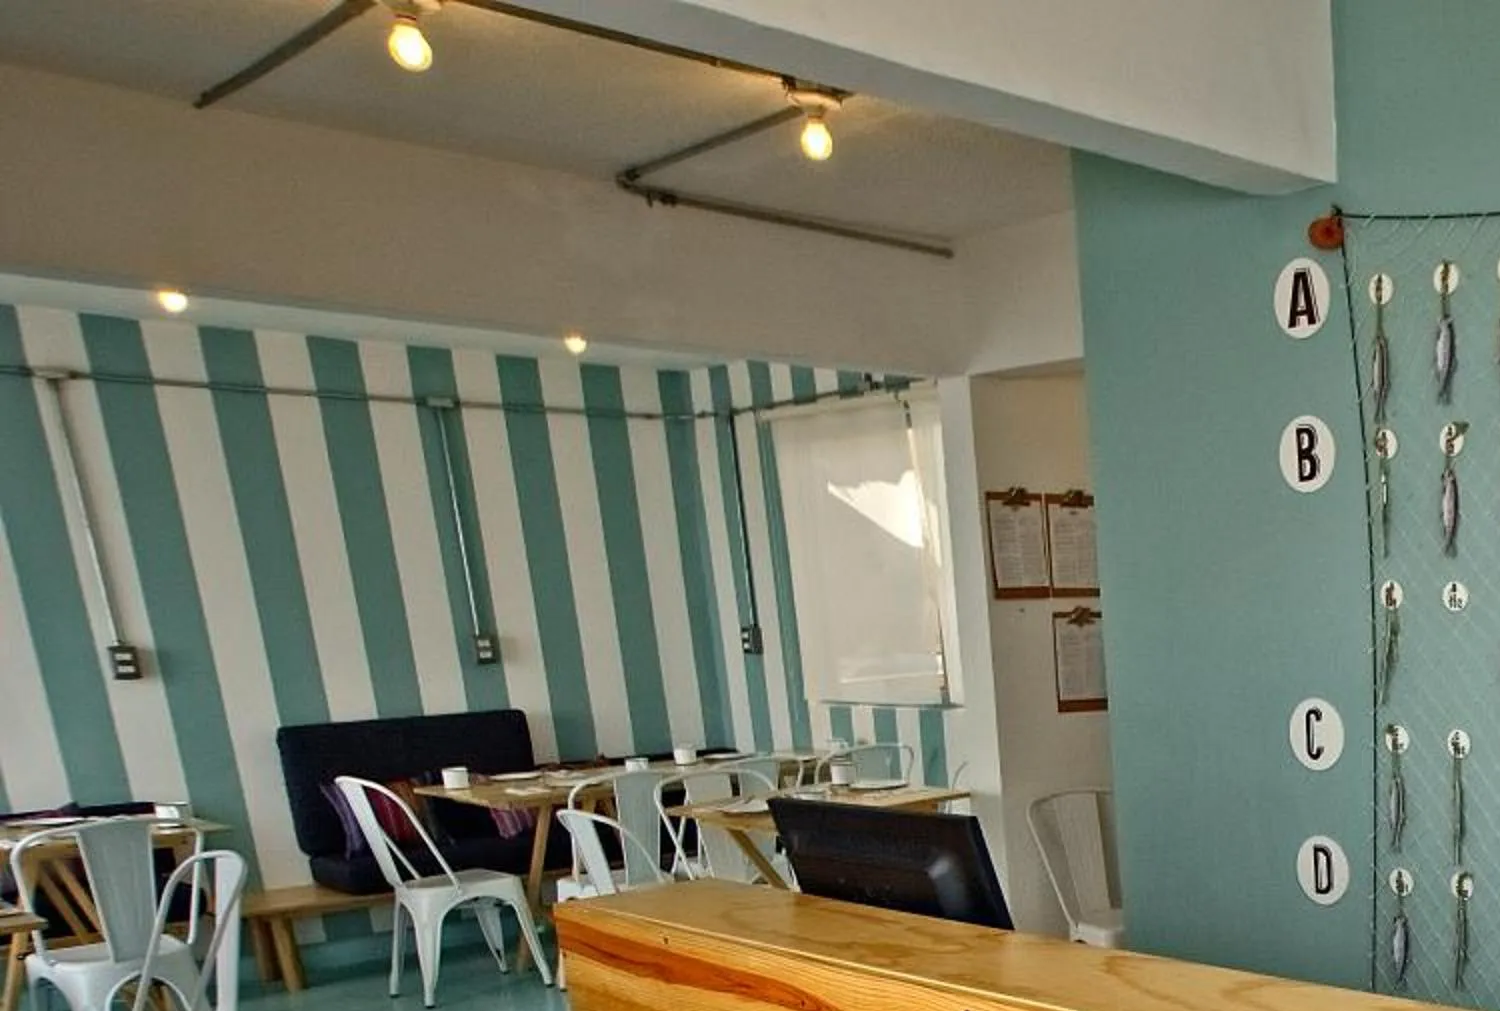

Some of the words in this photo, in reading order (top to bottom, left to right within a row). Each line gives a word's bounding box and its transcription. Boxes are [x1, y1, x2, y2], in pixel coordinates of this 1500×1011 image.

[1288, 267, 1321, 329] A
[1296, 422, 1321, 483] B
[1306, 706, 1324, 761] C
[1312, 844, 1335, 895] D
